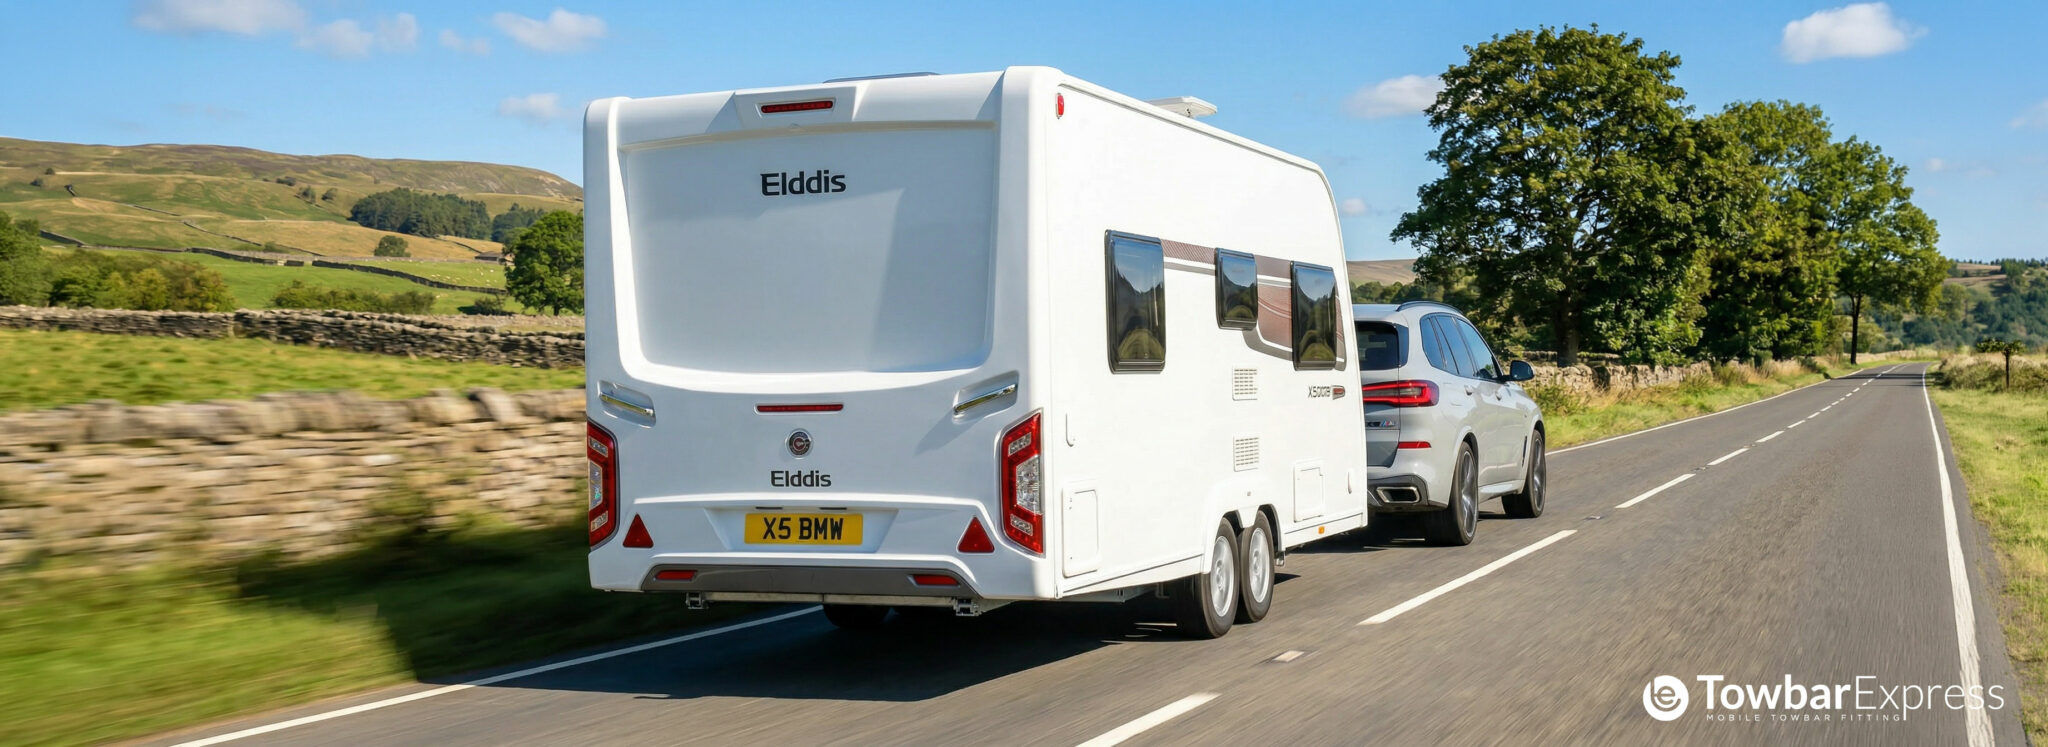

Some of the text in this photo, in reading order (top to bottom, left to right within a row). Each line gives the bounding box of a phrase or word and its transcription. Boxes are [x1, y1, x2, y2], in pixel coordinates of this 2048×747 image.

[760, 169, 847, 196] Elddis
[770, 470, 832, 487] Elddis
[762, 517, 844, 540] X5 BMW
